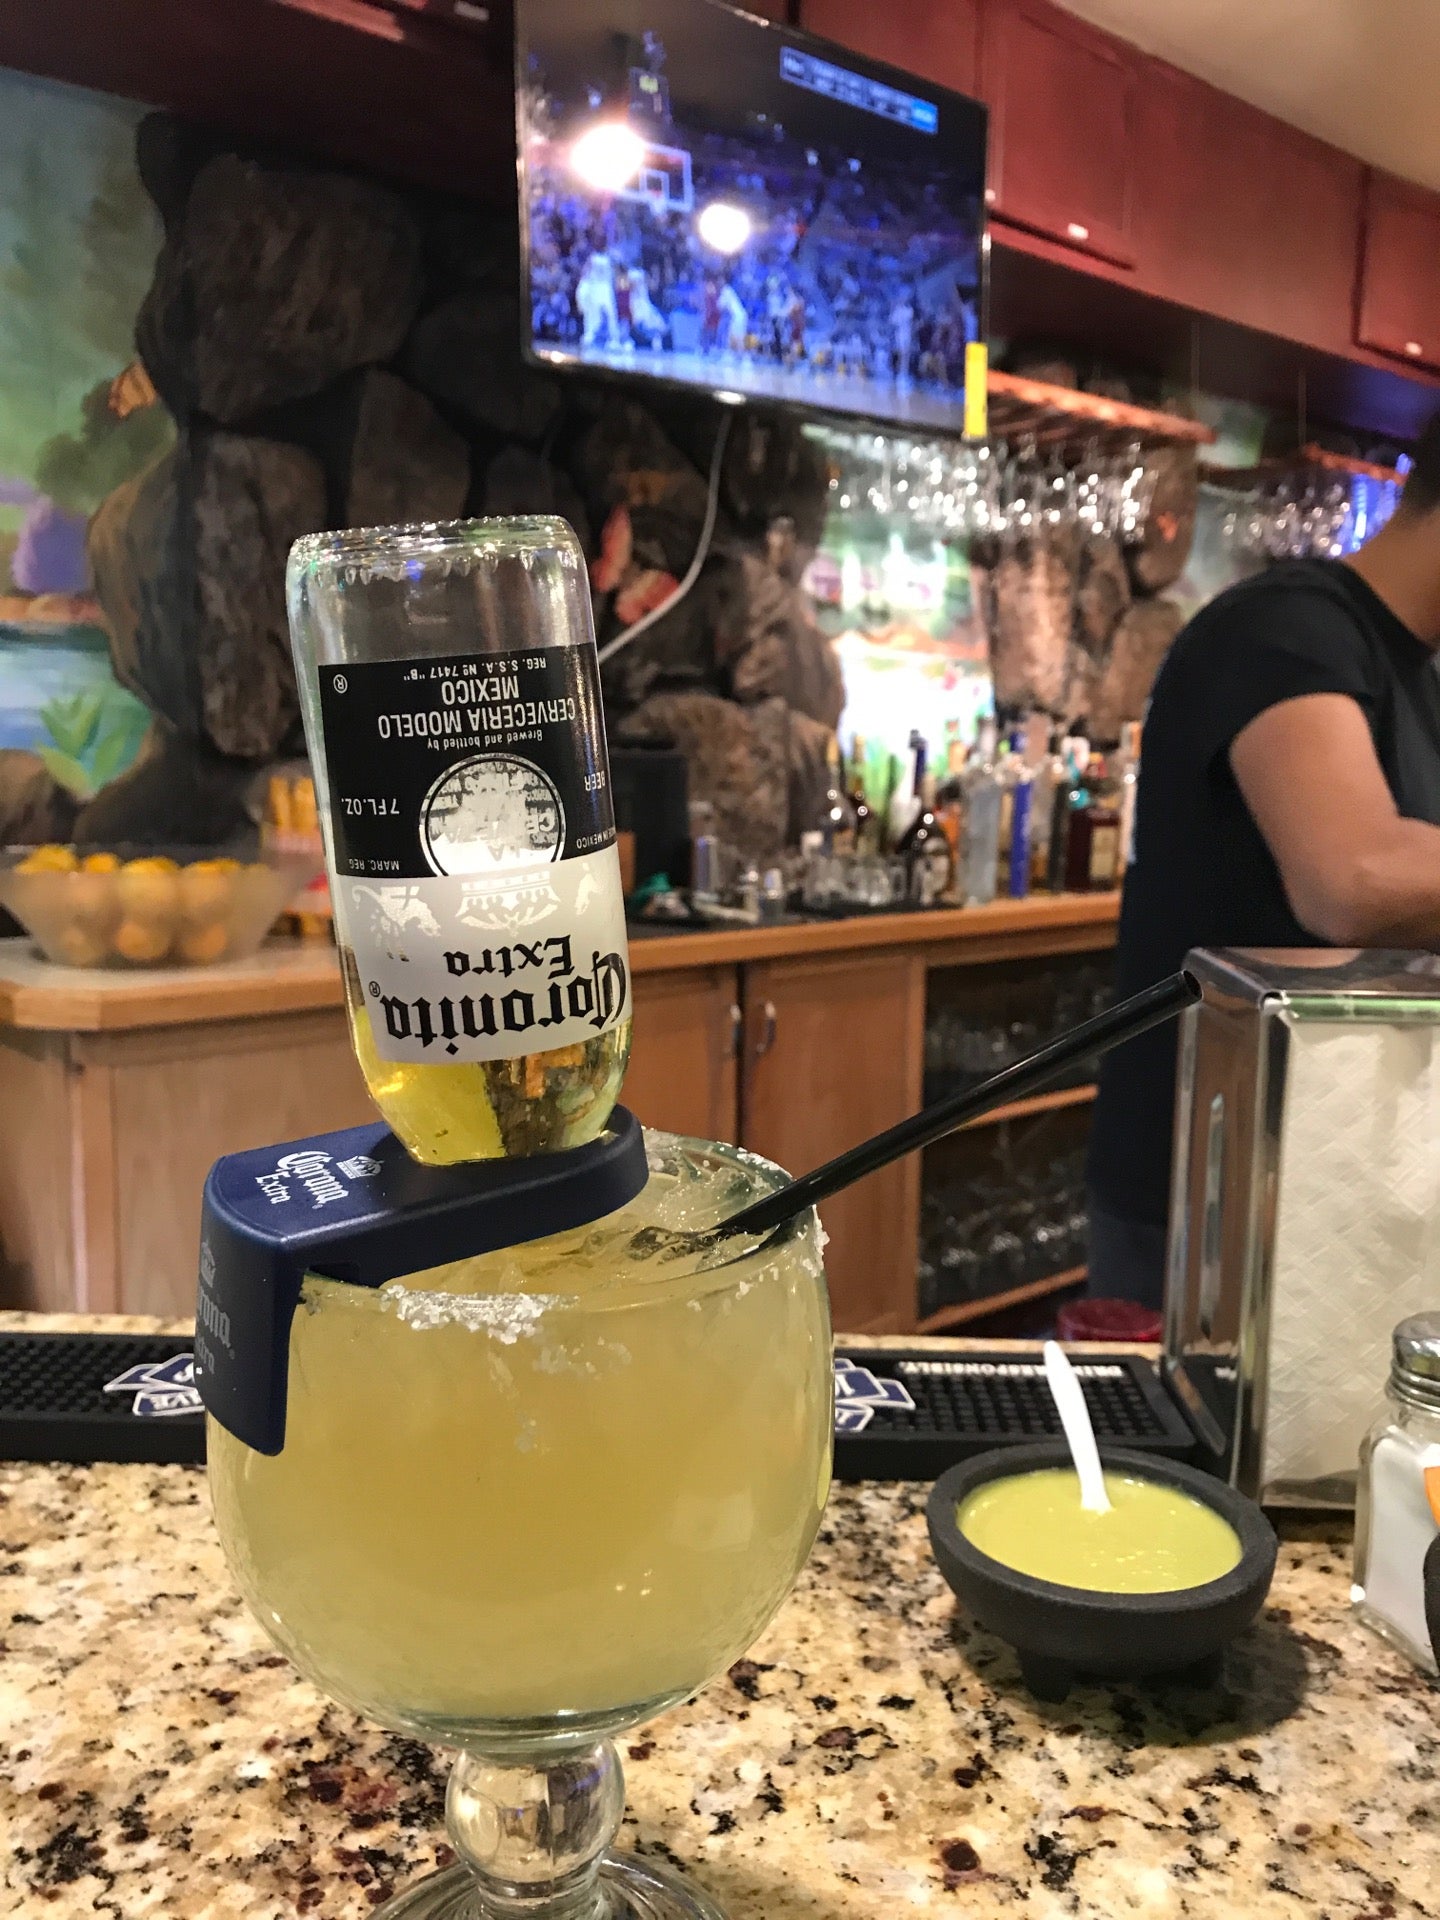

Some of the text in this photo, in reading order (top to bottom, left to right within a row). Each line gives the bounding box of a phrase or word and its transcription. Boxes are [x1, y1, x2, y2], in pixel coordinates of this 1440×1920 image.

[430, 665, 459, 679] 7417
[482, 658, 519, 673] S.S.A.
[522, 657, 547, 671] REG.
[441, 676, 520, 706] MEXICO
[378, 697, 576, 739] CERVECERIA MODELO
[428, 730, 543, 751] Brewed and bottled by
[584, 771, 606, 792] BEER
[390, 798, 400, 815] 7
[576, 831, 603, 849] MEXICO
[367, 859, 400, 871] MARC.
[443, 935, 575, 980] Extra
[379, 951, 627, 1055] Coronita
[255, 1171, 291, 1204] Extra
[275, 1151, 349, 1204] Corona
